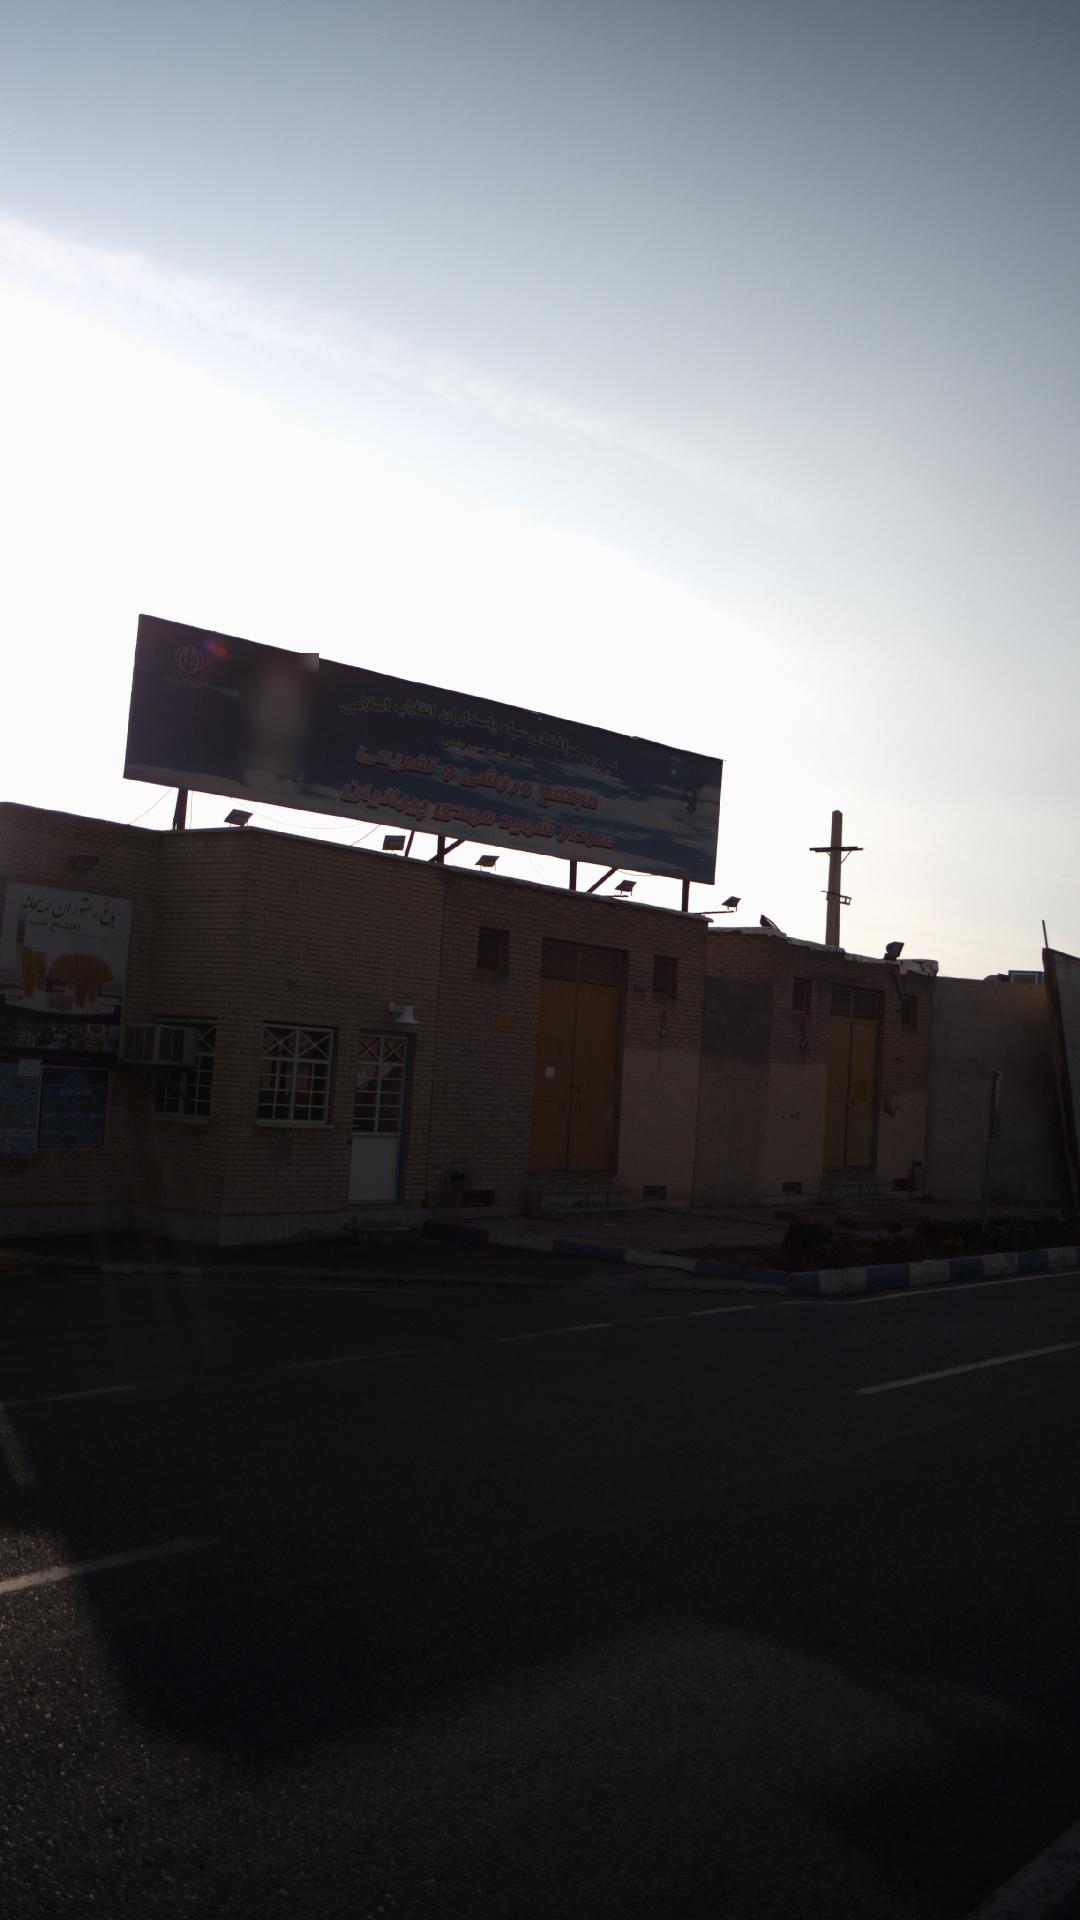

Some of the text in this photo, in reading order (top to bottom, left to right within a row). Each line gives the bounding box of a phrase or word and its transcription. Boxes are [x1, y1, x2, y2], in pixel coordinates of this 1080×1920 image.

[338, 695, 391, 716] اسلامی
[393, 698, 437, 719] انقلاب
[438, 706, 498, 736] پاسداران
[499, 721, 529, 741] سپاه
[354, 744, 600, 811] مجتمع ورزشی و تفریحی
[432, 801, 496, 828] مهدی
[498, 815, 555, 838] شهید
[556, 823, 617, 849] سردار
[50, 896, 99, 920] رستوران
[99, 900, 117, 930] باغ
